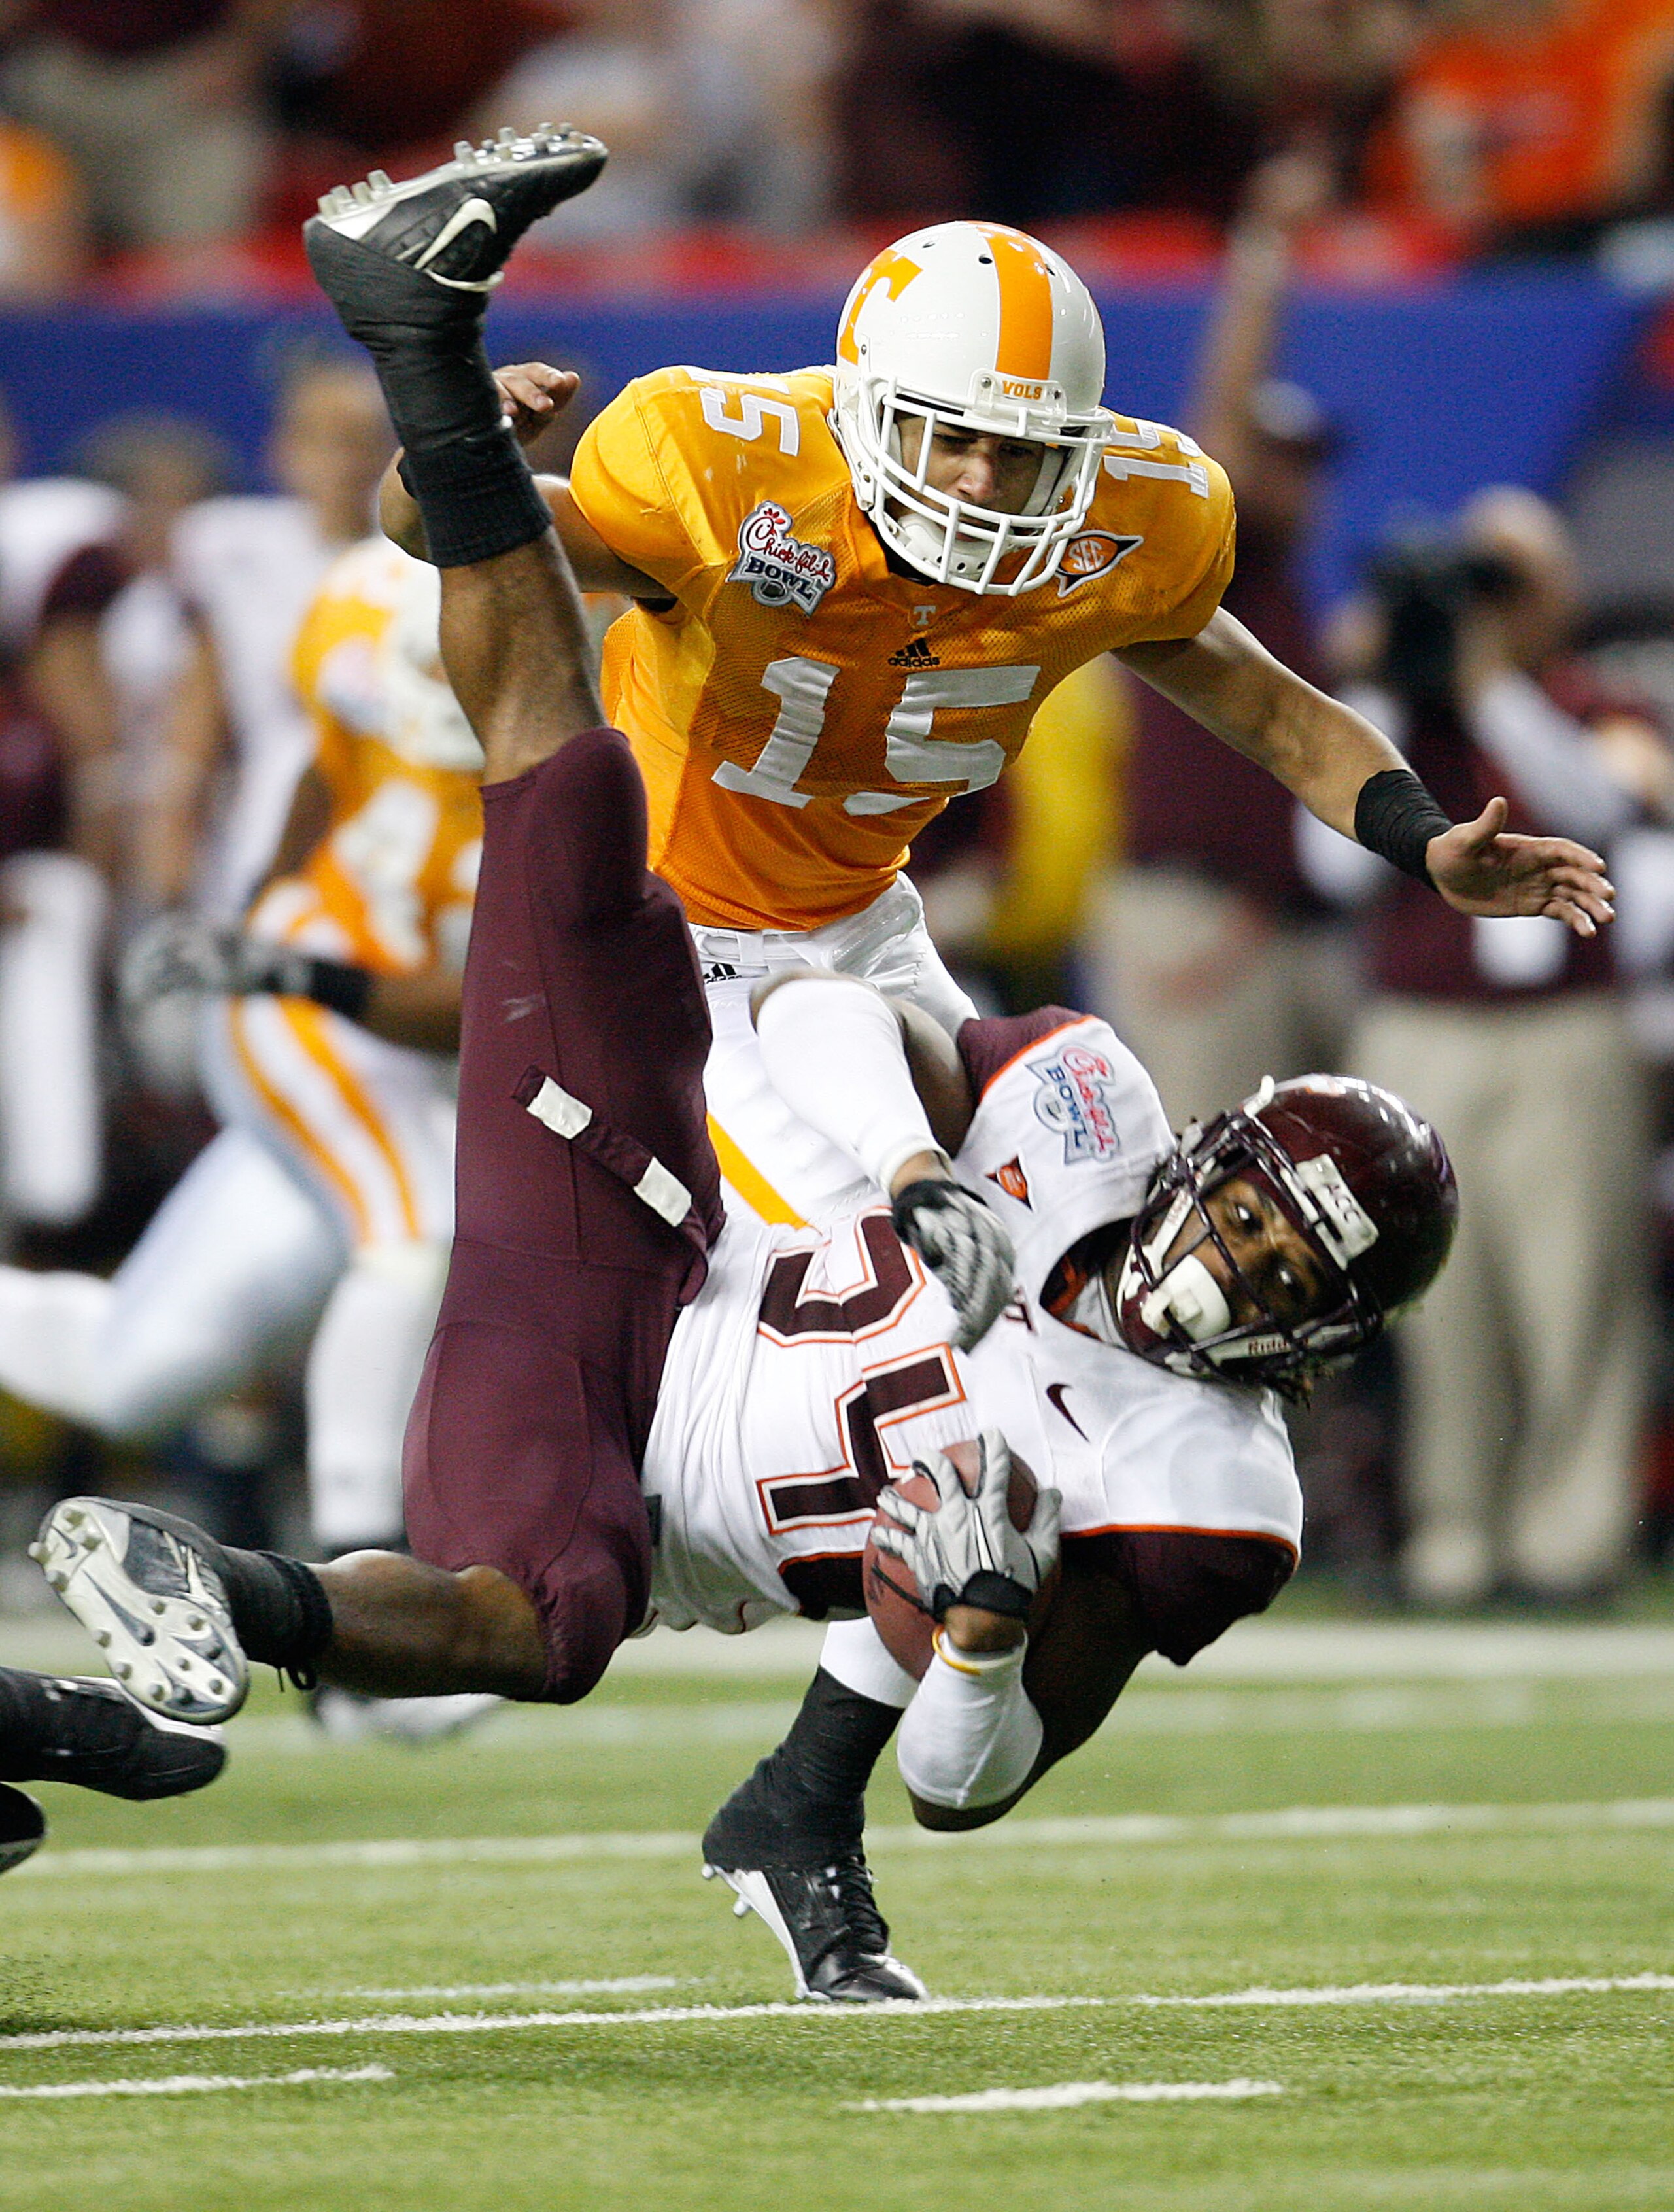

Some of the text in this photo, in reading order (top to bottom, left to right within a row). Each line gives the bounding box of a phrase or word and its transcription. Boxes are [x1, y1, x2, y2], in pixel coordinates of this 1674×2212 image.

[1002, 380, 1042, 400] VOLS
[1068, 540, 1105, 572] SEC
[745, 557, 813, 600] BOWL
[913, 605, 936, 625] T
[887, 656, 940, 668] adidas
[711, 656, 1041, 816] 15
[1046, 1059, 1087, 1148] BOWL
[1321, 1183, 1362, 1223] ACC
